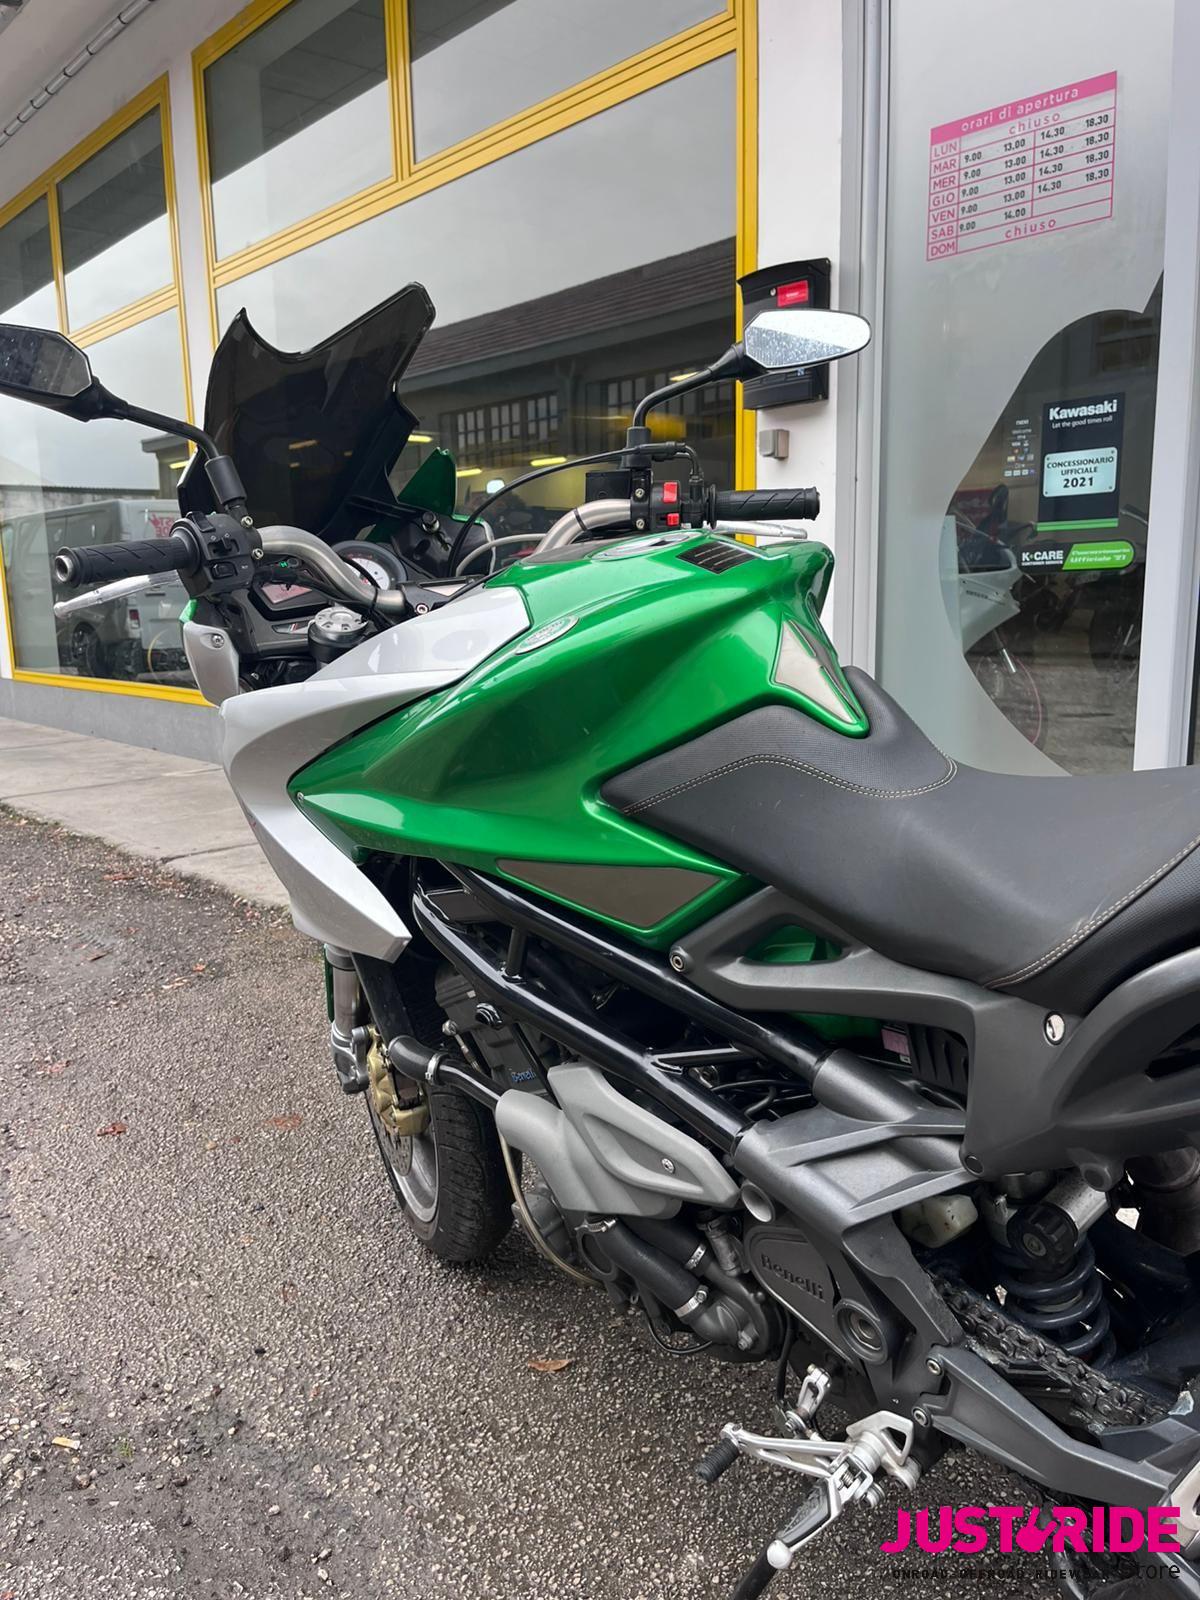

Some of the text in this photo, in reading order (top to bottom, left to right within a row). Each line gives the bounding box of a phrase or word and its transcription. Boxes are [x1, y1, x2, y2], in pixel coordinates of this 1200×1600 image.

[961, 88, 1079, 132] orari di apertura
[933, 114, 1109, 174] MAR 9.00 13.00 14.30 18.30
[934, 113, 1060, 158] LUN chiuso
[932, 132, 1109, 190] MER 9.00 13.00 14.30 18.30
[932, 150, 1109, 207] GIO 9.00 13.00 14.30 18.30
[931, 168, 1109, 223] VEN 9.00 13.00 14.30 18.30
[930, 219, 1056, 256] DOM chiuso
[931, 208, 1026, 240] SAB 9.00 14.00
[1049, 399, 1118, 421] Kawasaki
[1072, 418, 1087, 428] good
[1087, 417, 1102, 425] times
[1047, 456, 1114, 469] CONCESSIONARIO
[1061, 466, 1098, 476] UFFICIALE
[1063, 477, 1094, 489] 2021
[761, 1253, 824, 1302] Benelli
